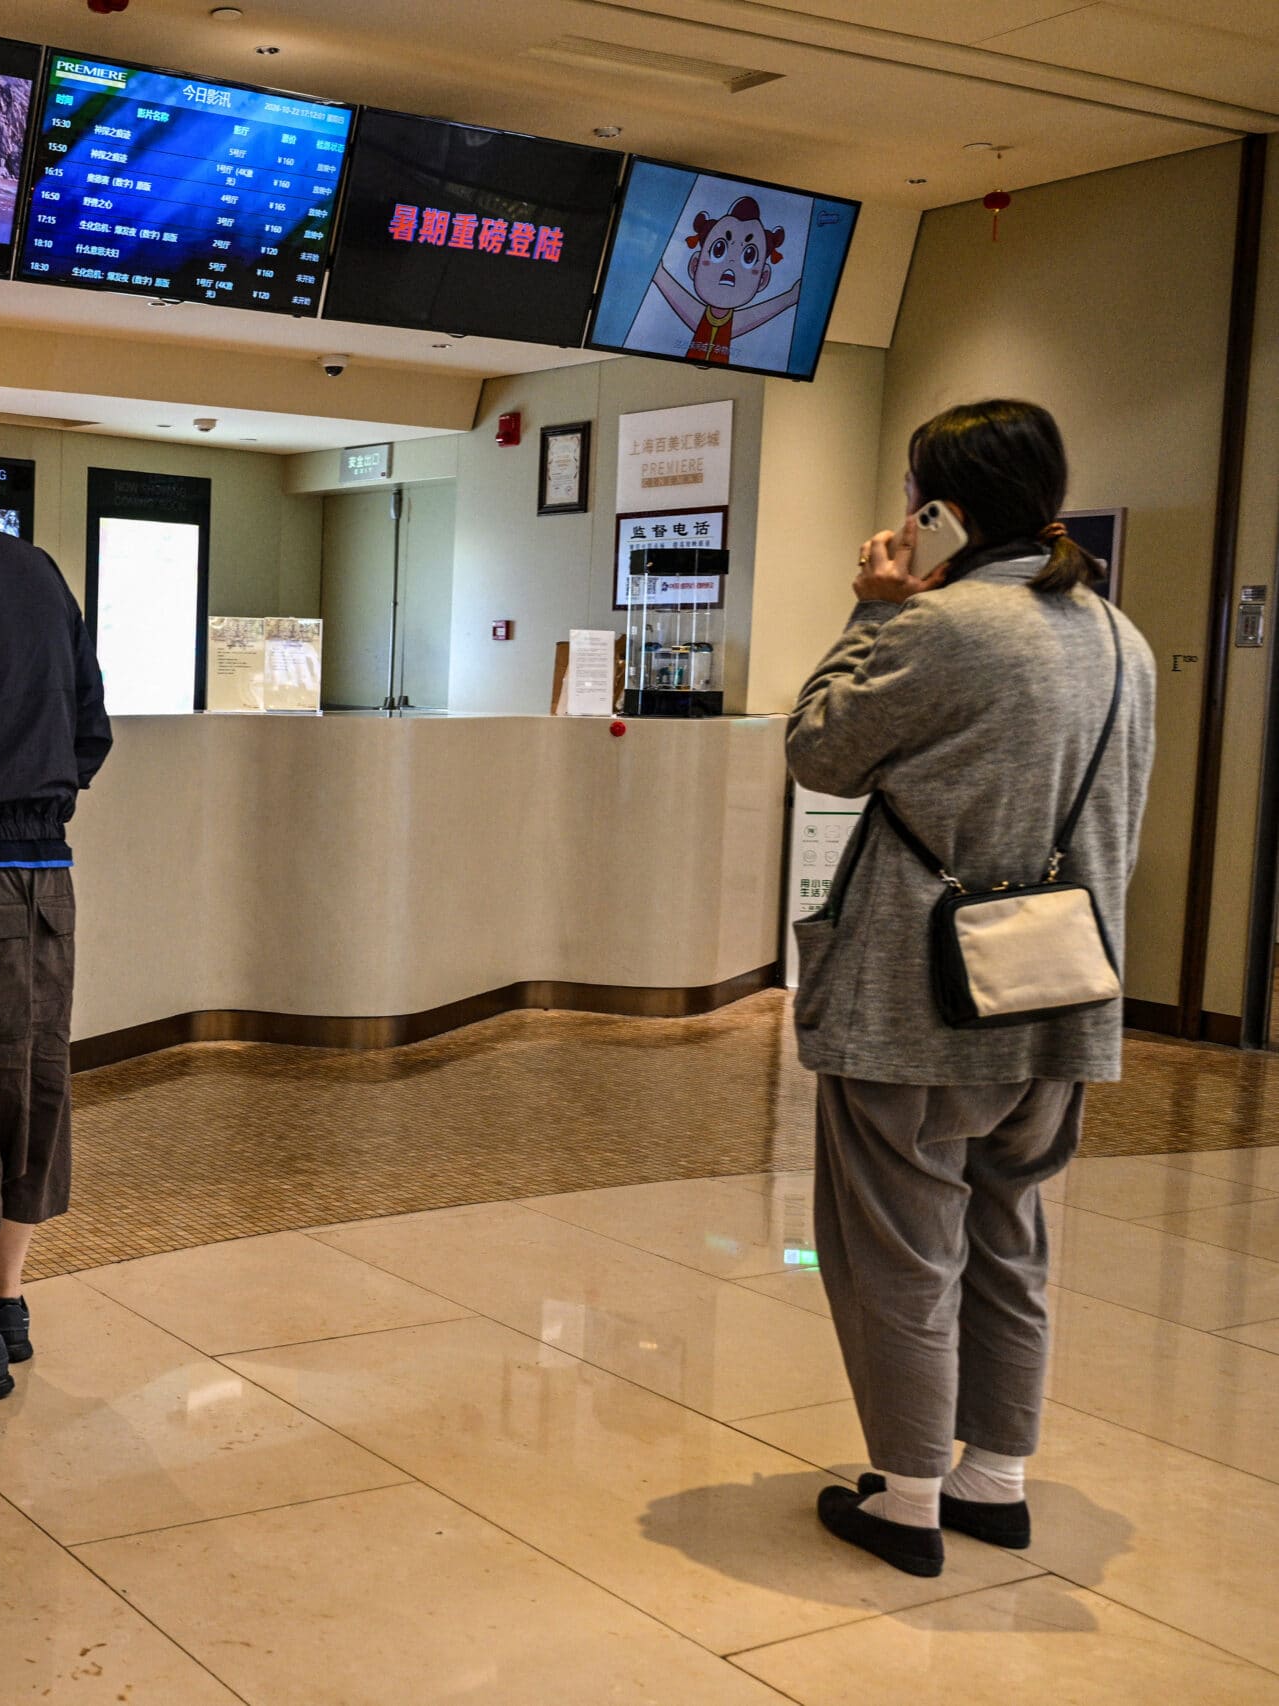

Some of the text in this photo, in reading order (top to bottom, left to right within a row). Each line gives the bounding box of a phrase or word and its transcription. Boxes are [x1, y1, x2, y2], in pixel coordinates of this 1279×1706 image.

[56, 60, 127, 82] PREMIERE
[182, 84, 231, 108] 今日影讯
[137, 107, 170, 123] 影片名称
[51, 118, 72, 129] 15:30
[48, 142, 68, 153] 15:50
[44, 166, 64, 177] 16:15
[40, 190, 61, 201] 16:50
[37, 214, 57, 225] 17:15
[387, 203, 565, 263] 暑期重磅登陆
[33, 238, 54, 249] 18:10
[30, 261, 50, 272] 18:30
[627, 429, 721, 456] 上海百美汇影城
[347, 452, 380, 469] 安全出口
[640, 457, 705, 477] PREMIERE
[630, 521, 711, 540] 监督电话
